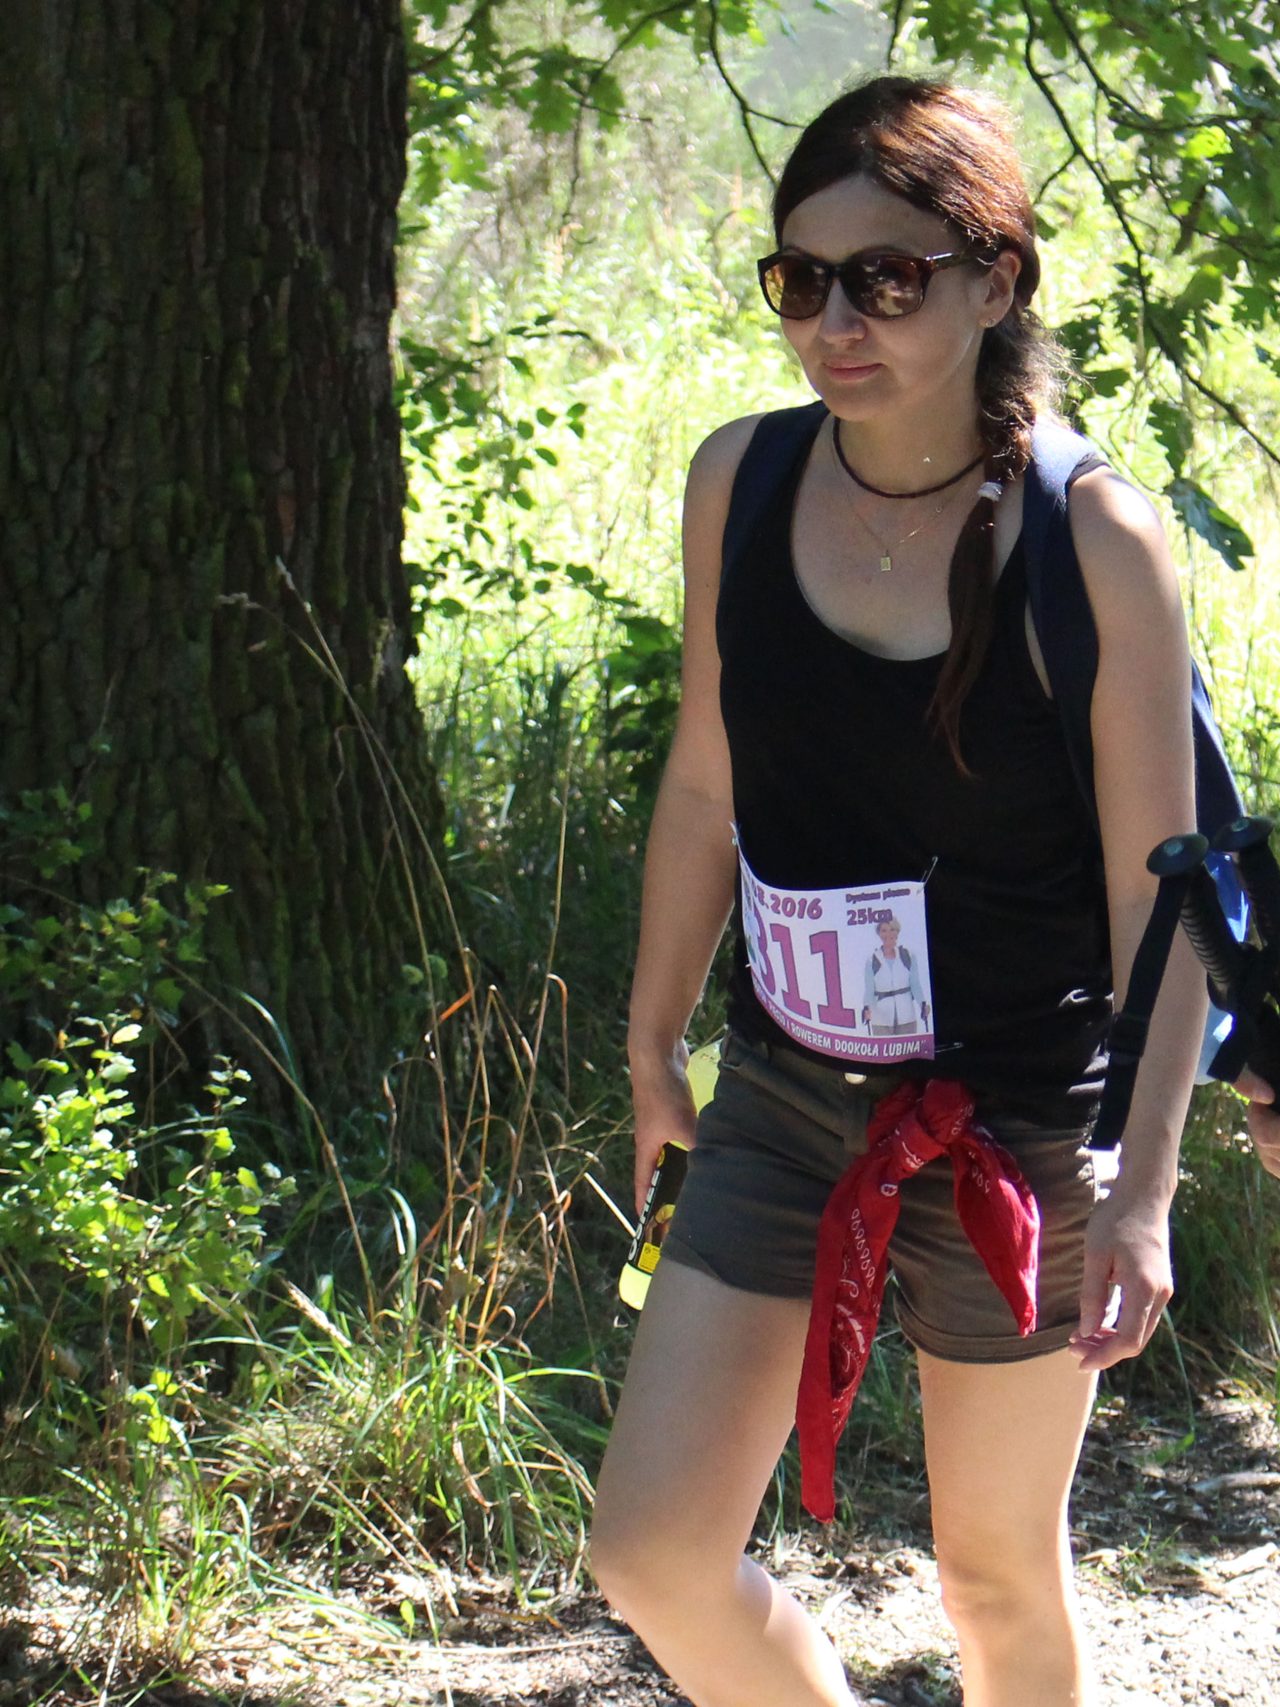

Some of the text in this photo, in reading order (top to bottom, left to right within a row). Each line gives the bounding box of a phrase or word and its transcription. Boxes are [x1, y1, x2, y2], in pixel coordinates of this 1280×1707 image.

[847, 907, 893, 926] 25km
[753, 897, 856, 1029] 311
[790, 1022, 832, 1049] ROWEREM
